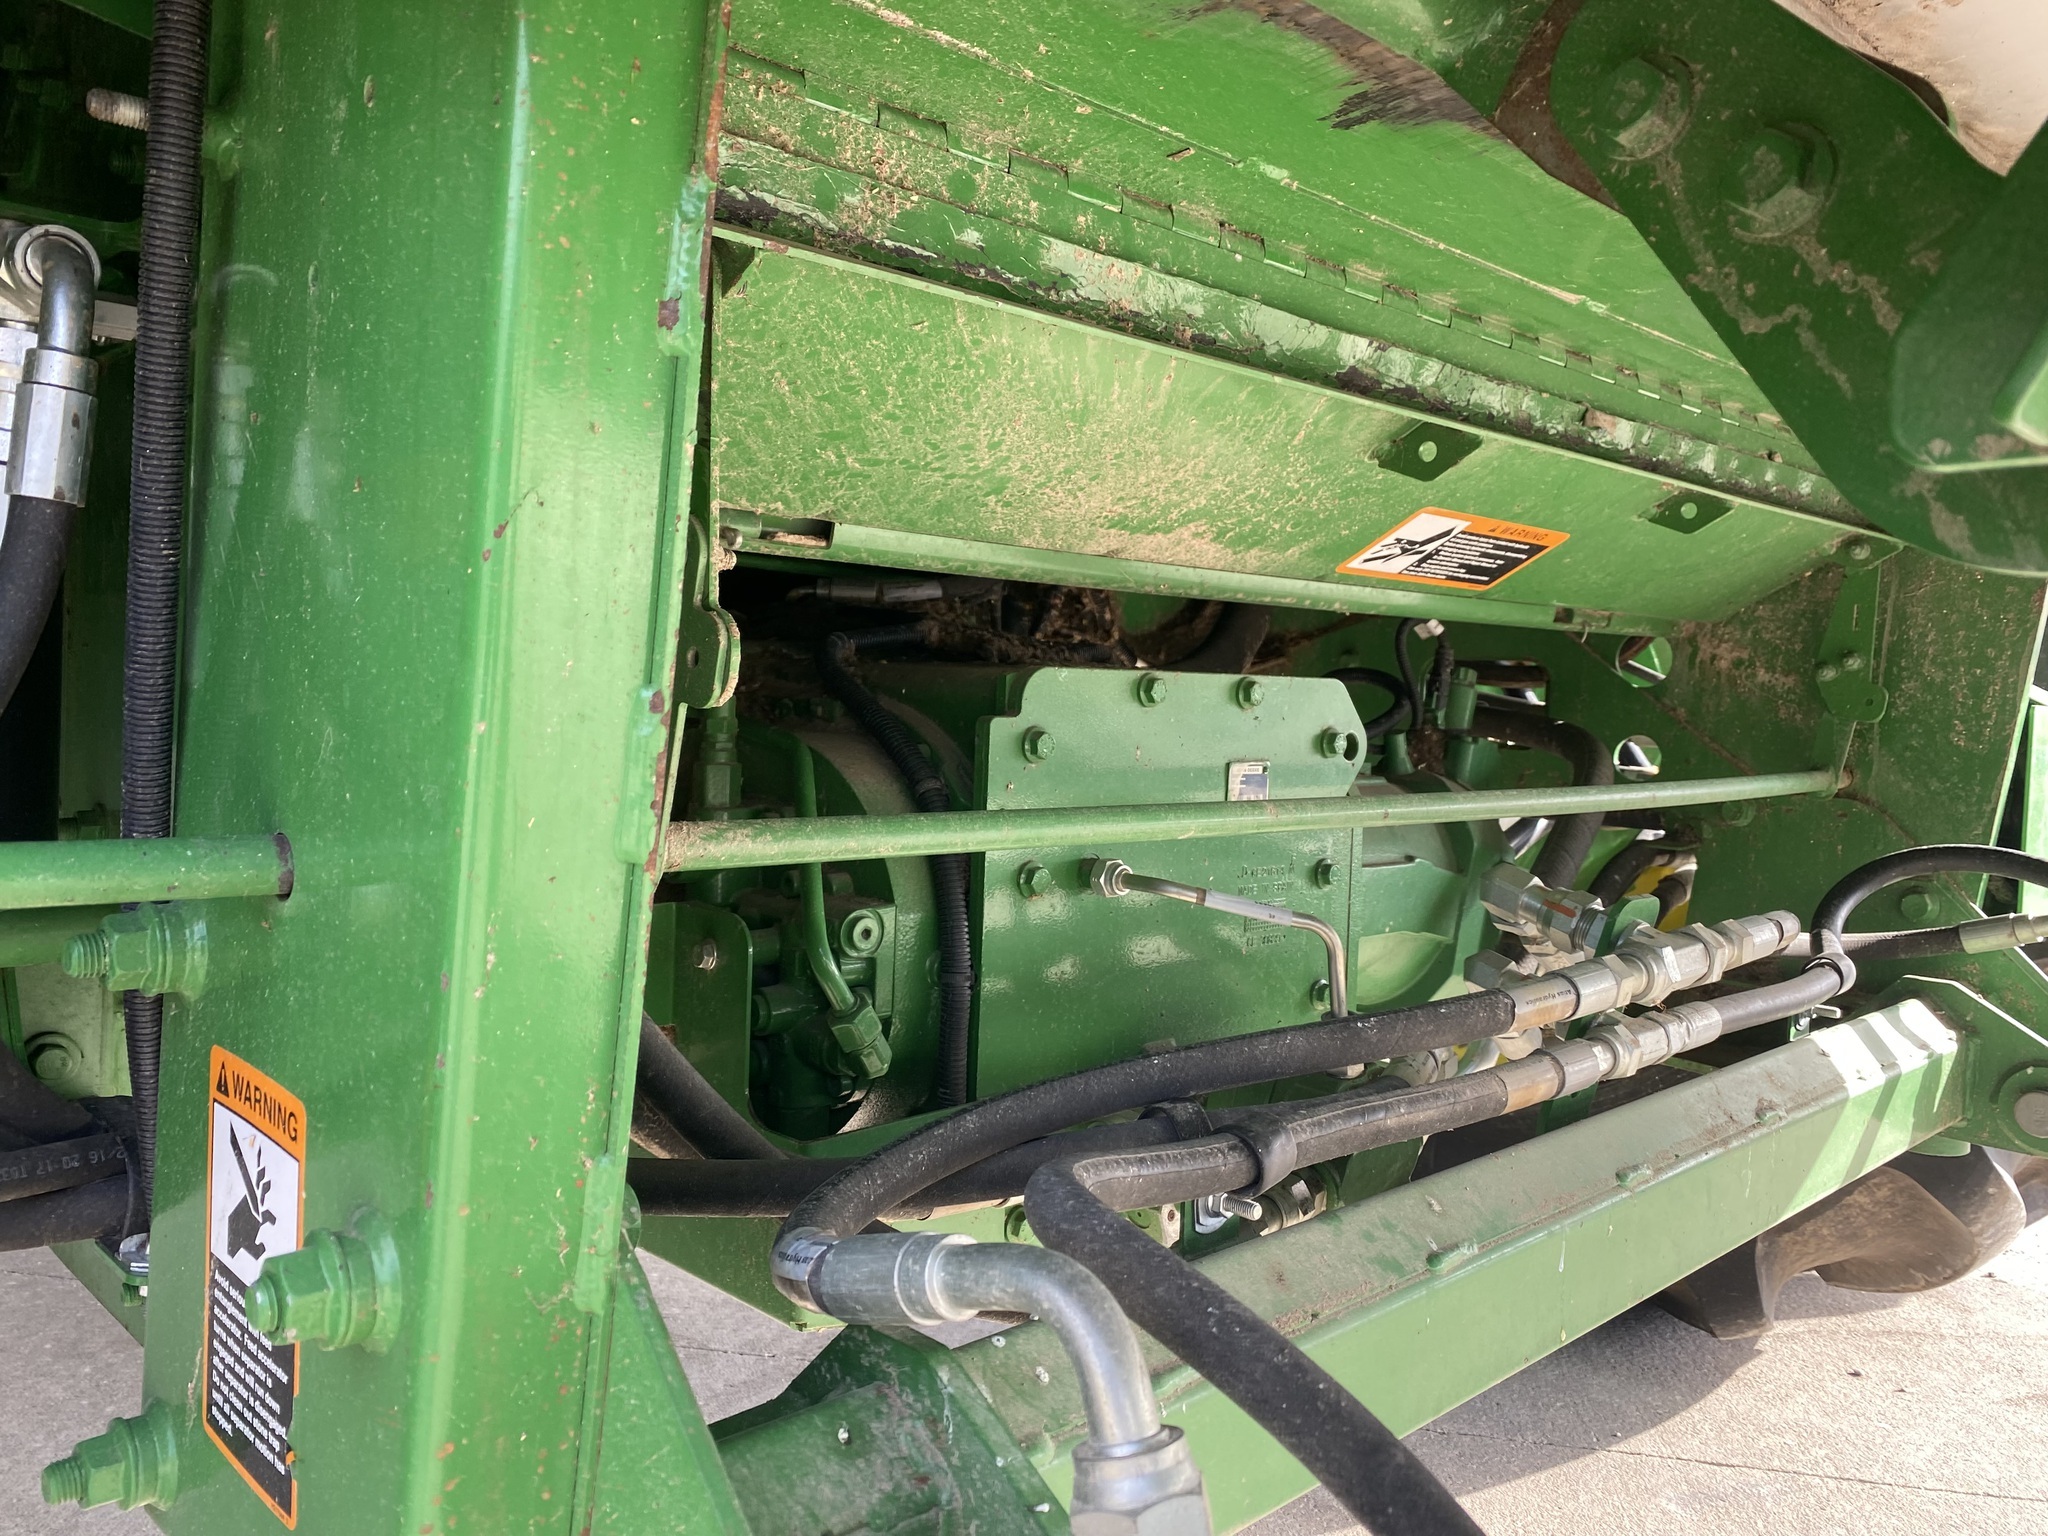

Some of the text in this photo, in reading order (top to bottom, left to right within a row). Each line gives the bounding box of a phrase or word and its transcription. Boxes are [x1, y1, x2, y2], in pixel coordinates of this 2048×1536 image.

[1499, 526, 1549, 541] WARNING
[232, 1069, 298, 1143] WARNING
[229, 1285, 246, 1308] seriou
[226, 1336, 241, 1357] when
[266, 1373, 272, 1388] is
[243, 1333, 258, 1356] Feed
[224, 1369, 248, 1400] separator
[248, 1392, 254, 1407] is
[234, 1362, 245, 1379] and
[244, 1372, 255, 1389] will
[254, 1382, 264, 1399] run
[264, 1392, 280, 1415] down
[212, 1369, 220, 1386] Do
[219, 1380, 229, 1397] not
[243, 1407, 253, 1423] out
[252, 1417, 268, 1439] stone
[268, 1431, 280, 1453] trap
[254, 1437, 274, 1464] motion
[274, 1455, 285, 1475] has
